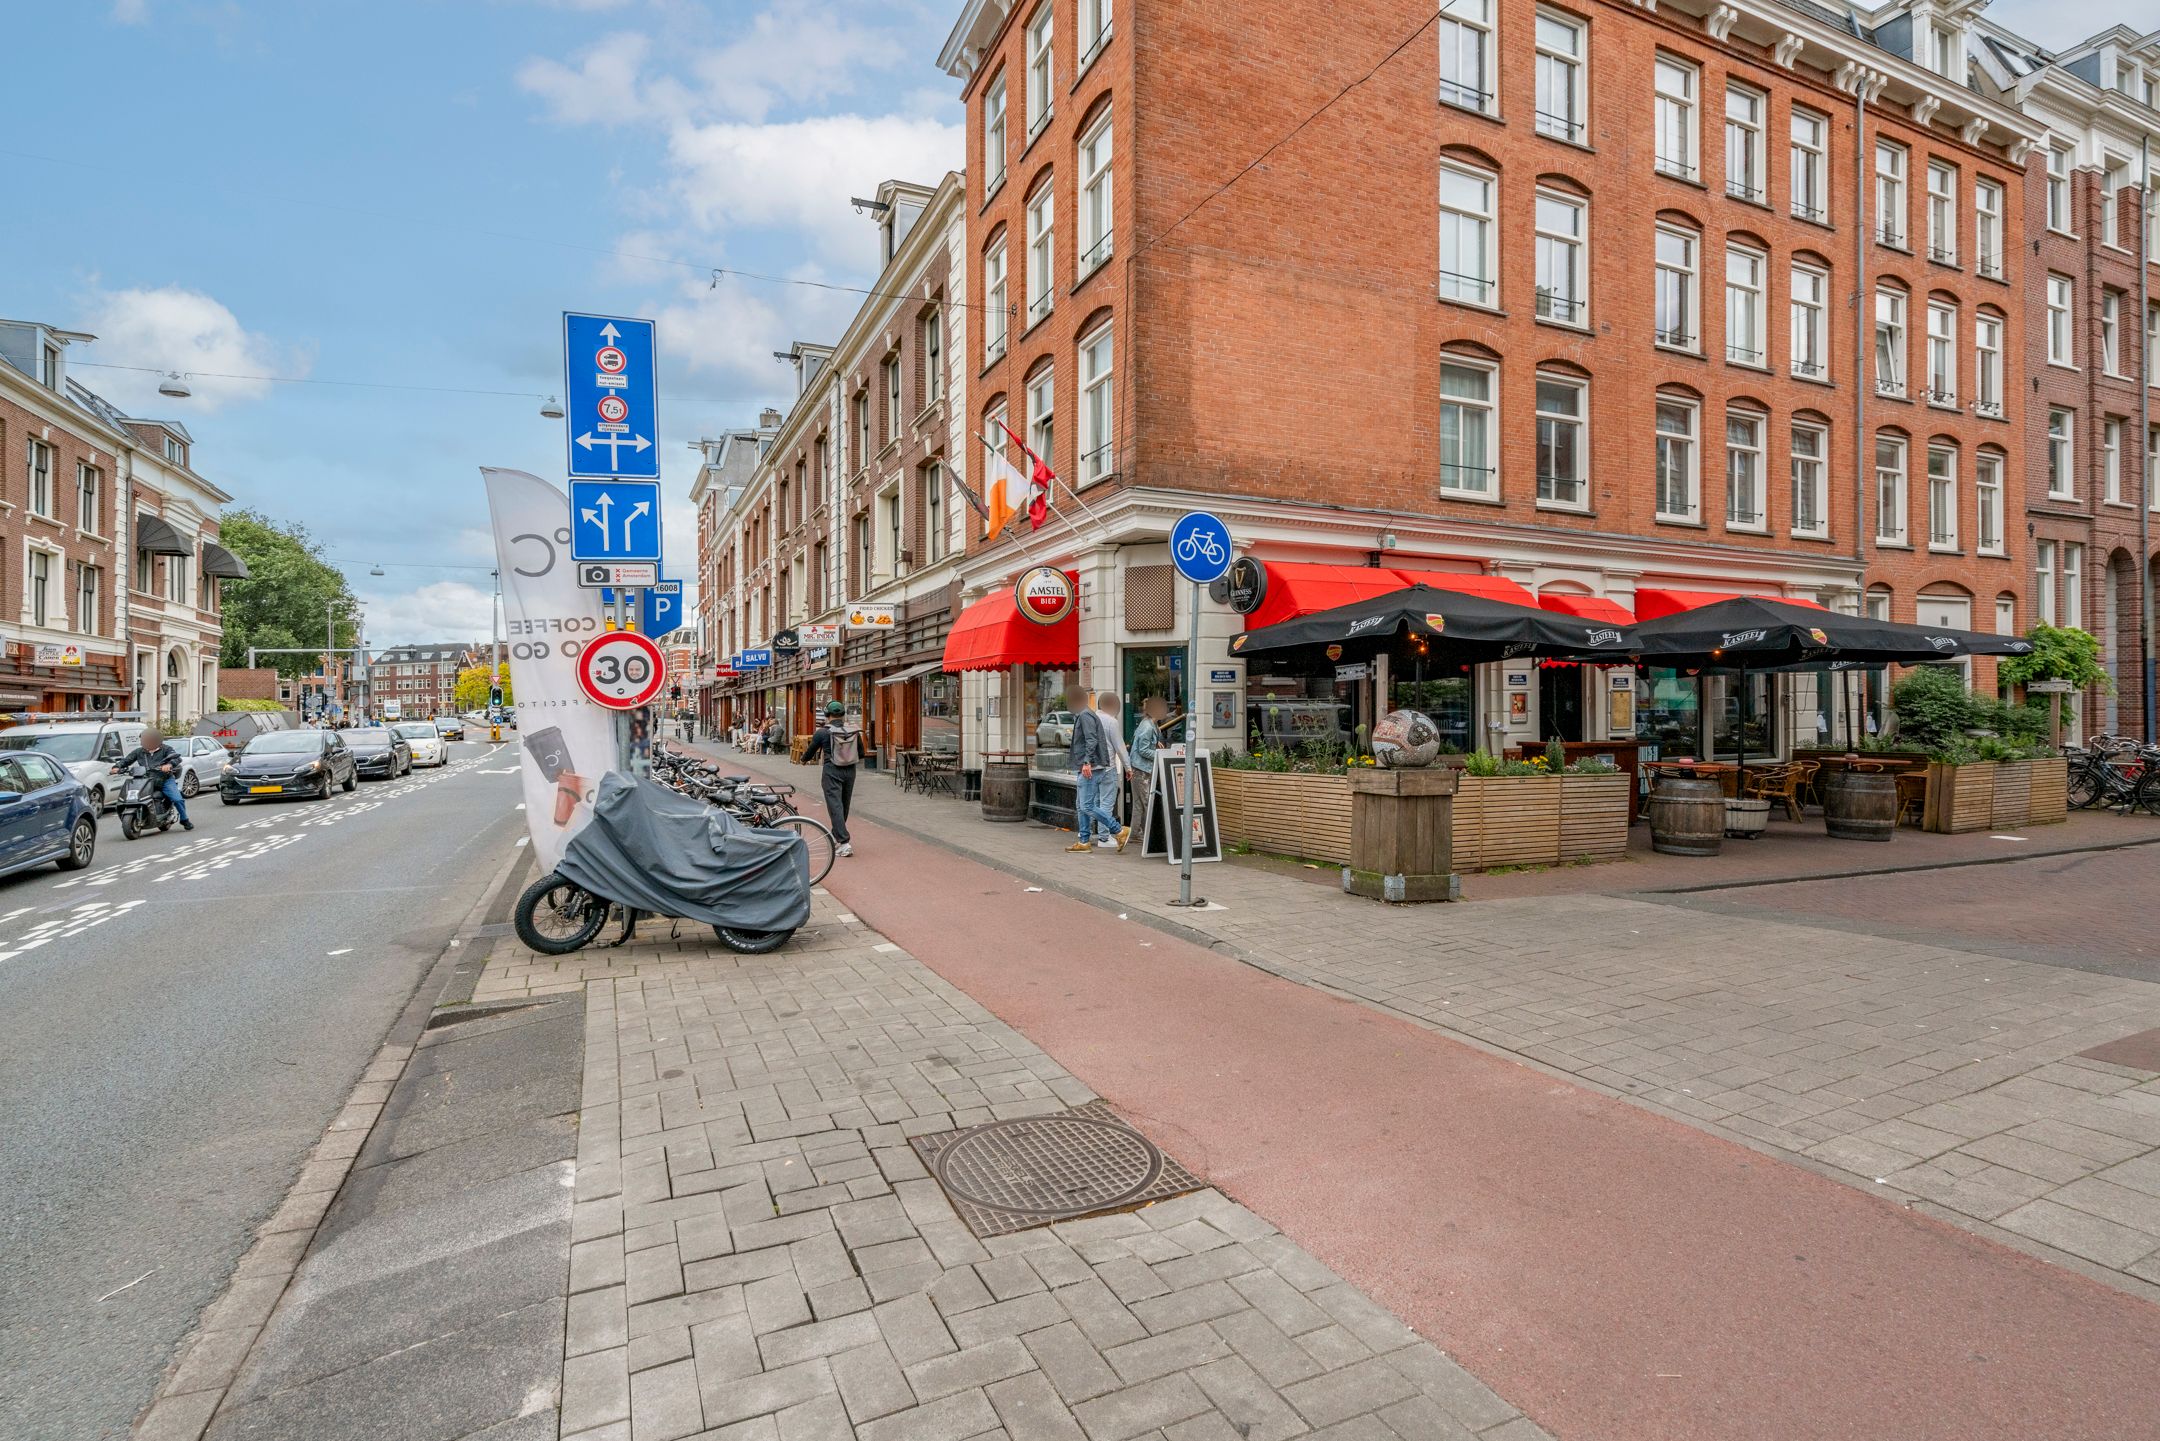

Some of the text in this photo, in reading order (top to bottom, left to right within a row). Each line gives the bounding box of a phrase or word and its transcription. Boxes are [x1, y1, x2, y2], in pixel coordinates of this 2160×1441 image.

[1030, 586, 1065, 595] AMSTEL
[1230, 587, 1252, 596] GUINNESS
[1040, 597, 1057, 605] BIER
[655, 597, 671, 621] P
[1590, 630, 1617, 644] KASTEEL
[1723, 631, 1761, 646] KASTEEL
[746, 653, 766, 662] SALVO
[595, 655, 650, 684] 30
